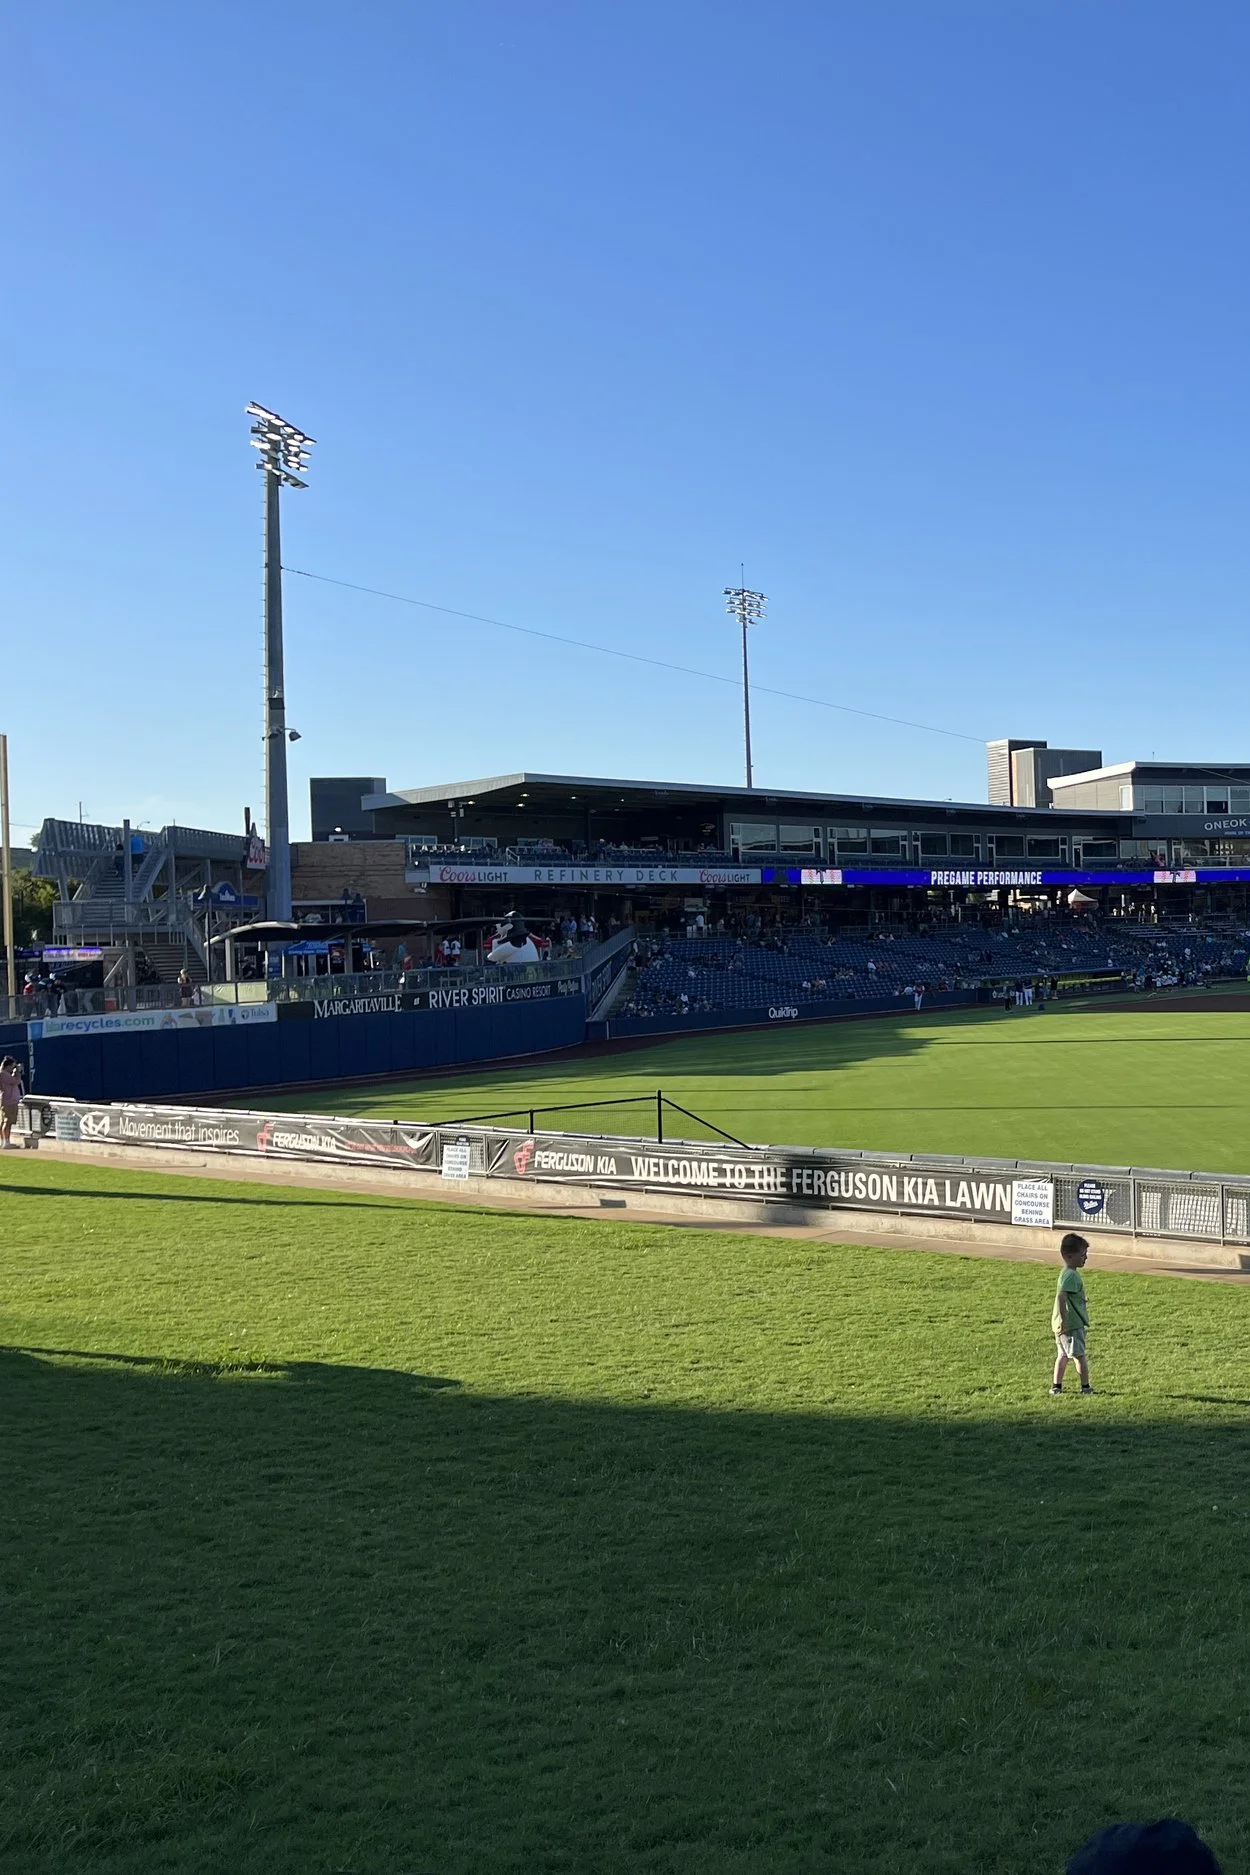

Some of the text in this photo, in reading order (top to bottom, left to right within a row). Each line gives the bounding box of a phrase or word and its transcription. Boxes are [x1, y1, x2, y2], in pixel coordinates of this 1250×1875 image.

[1204, 818, 1247, 831] ONEOK
[439, 866, 750, 883] Coors LIGHT REFINERY DECK Coors LIGHT
[931, 871, 1042, 885] PREGAME PERFORMANCE
[429, 988, 468, 1009] RIVER
[472, 986, 504, 1006] SPIRIT
[506, 987, 531, 1000] CASINO
[532, 984, 551, 998] RESORT
[250, 1008, 269, 1019] Tulsa
[768, 1006, 798, 1019] QuikTrip
[119, 1117, 172, 1139] Movement
[173, 1121, 195, 1141] that
[198, 1124, 240, 1147] inspires
[272, 1131, 320, 1151] FERGUSON
[321, 1135, 336, 1151] KIA
[534, 1151, 1012, 1212] FERGUSON KIA WELCOME TO THE FERGUSON KIA LAWN
[1017, 1183, 1036, 1191] PLACE
[1014, 1200, 1050, 1208] CONCOURSE
[1021, 1208, 1043, 1216] BEHIND
[1014, 1216, 1034, 1224] GRASS
